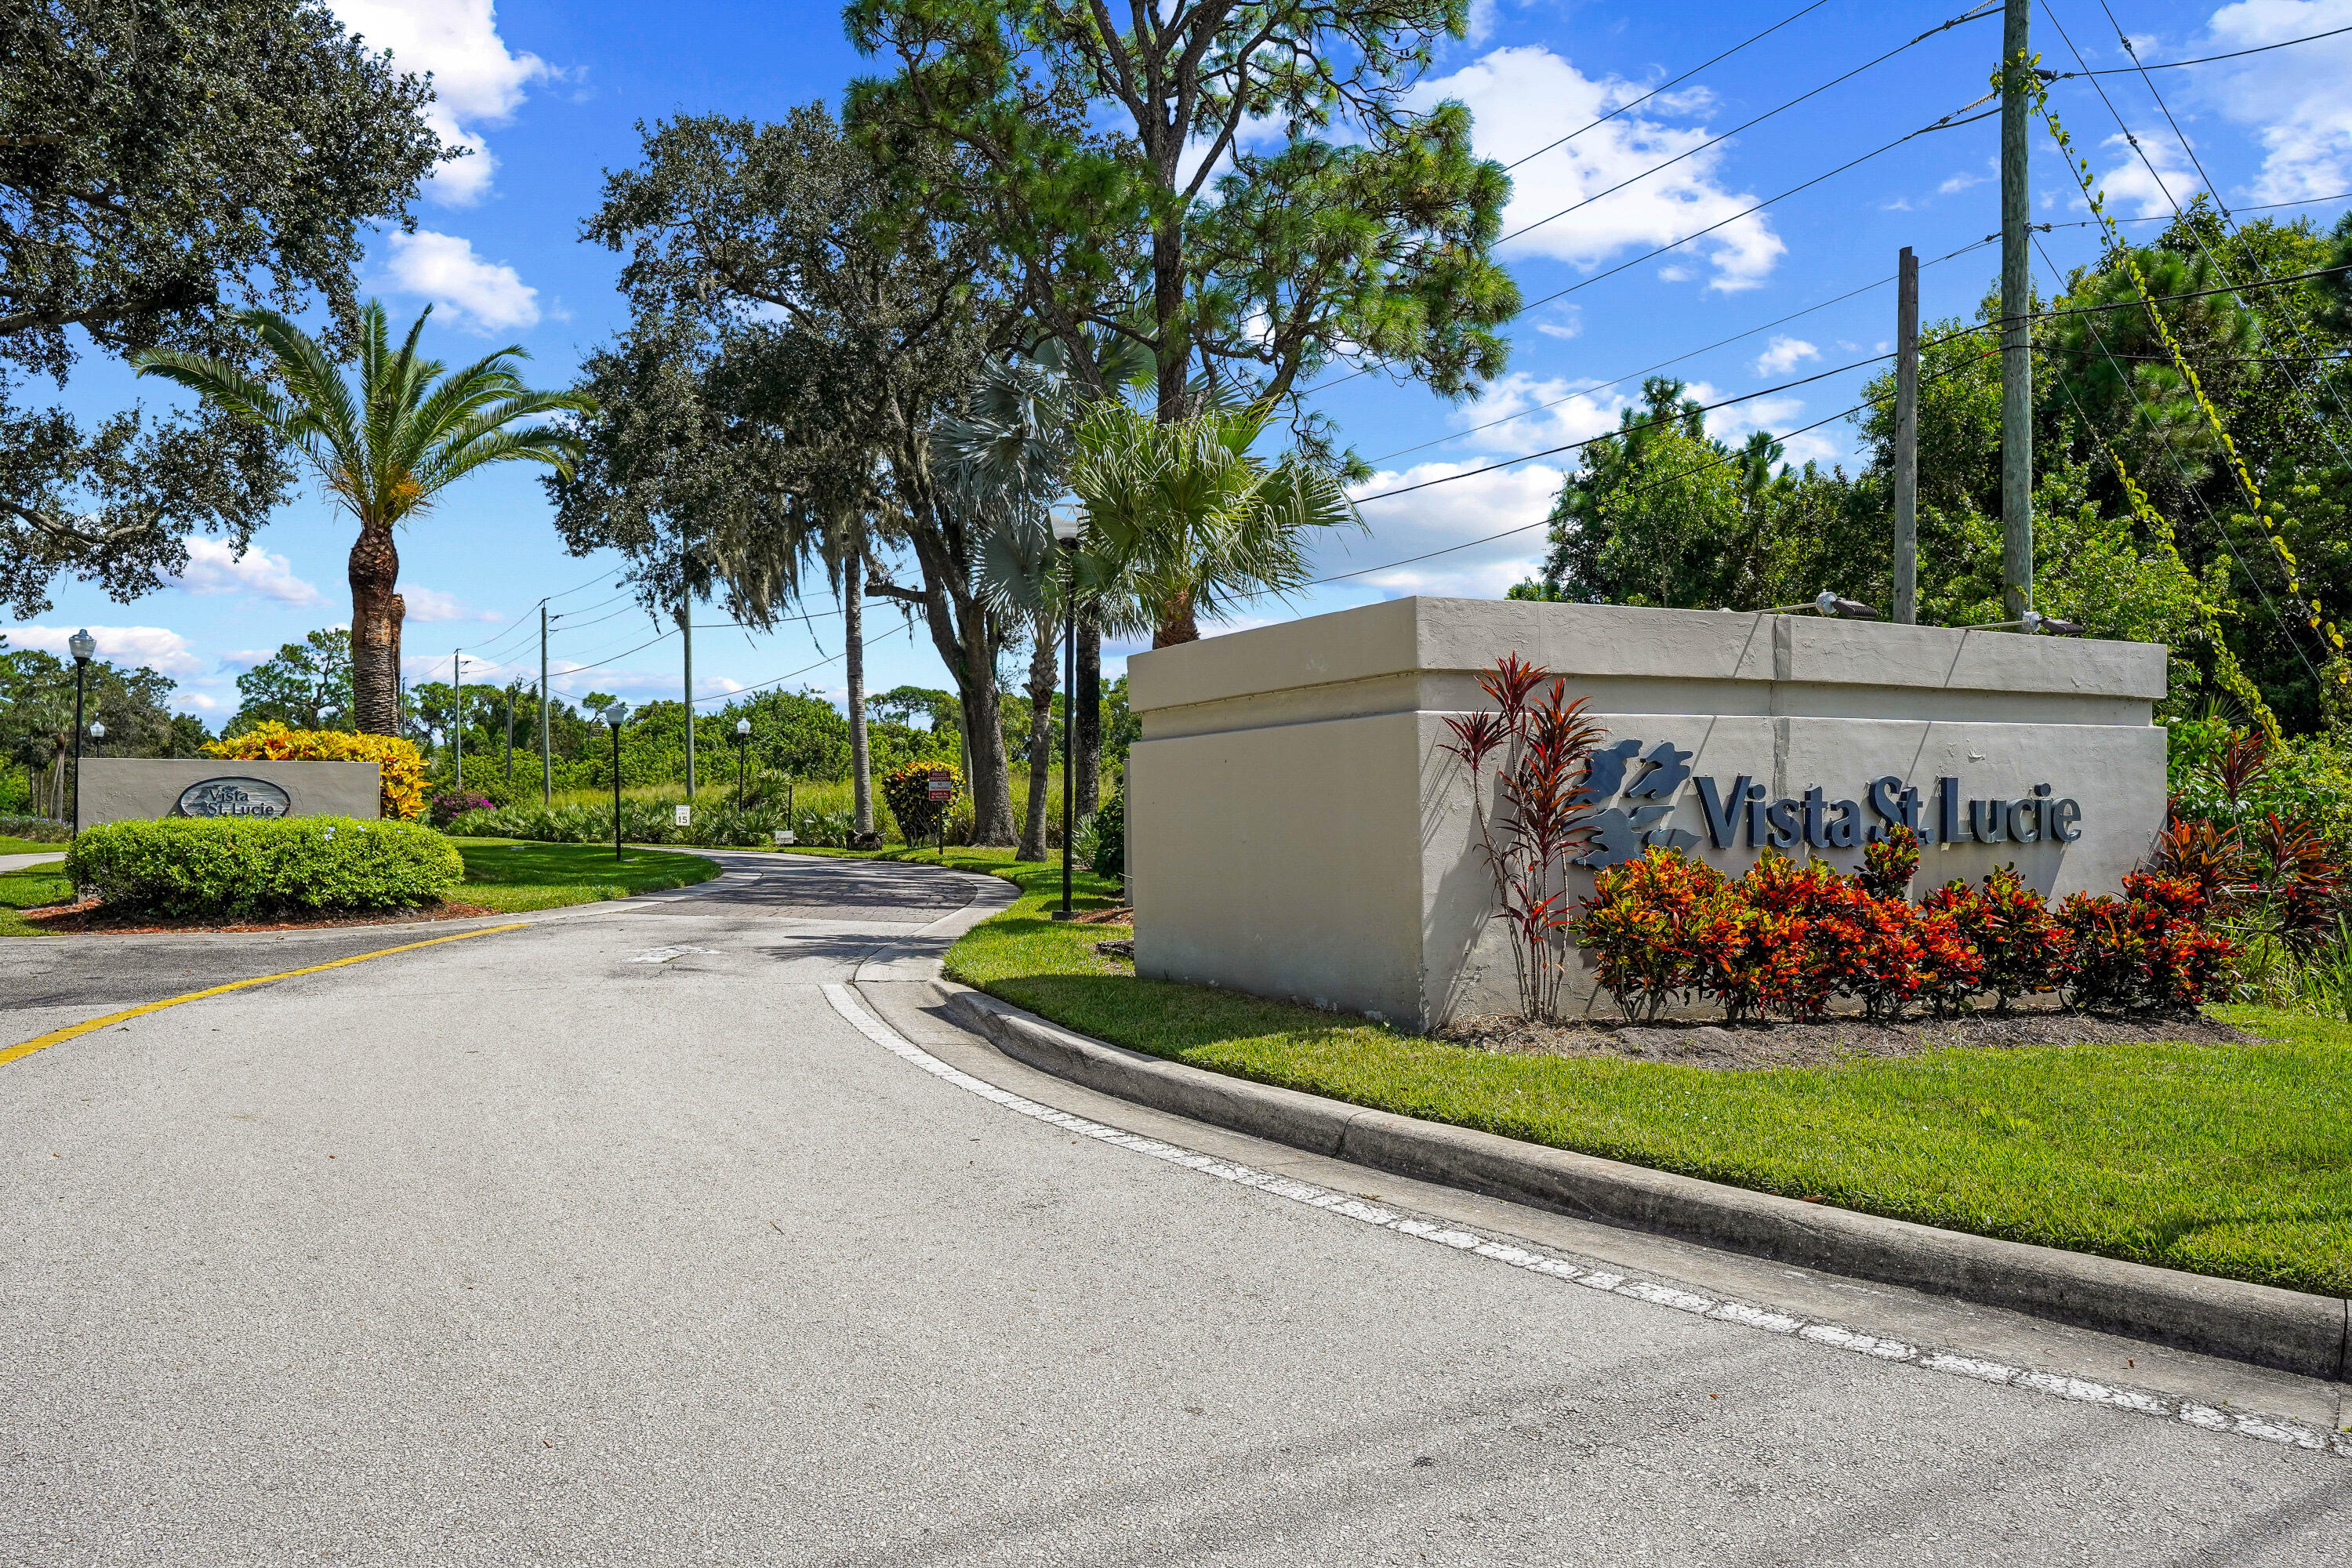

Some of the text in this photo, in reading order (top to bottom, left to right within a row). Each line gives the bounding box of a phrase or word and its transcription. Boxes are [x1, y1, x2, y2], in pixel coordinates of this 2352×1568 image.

[208, 789, 249, 802] Vista
[208, 802, 274, 815] St. Lucie
[1693, 775, 2082, 848] Vista St. Lucie
